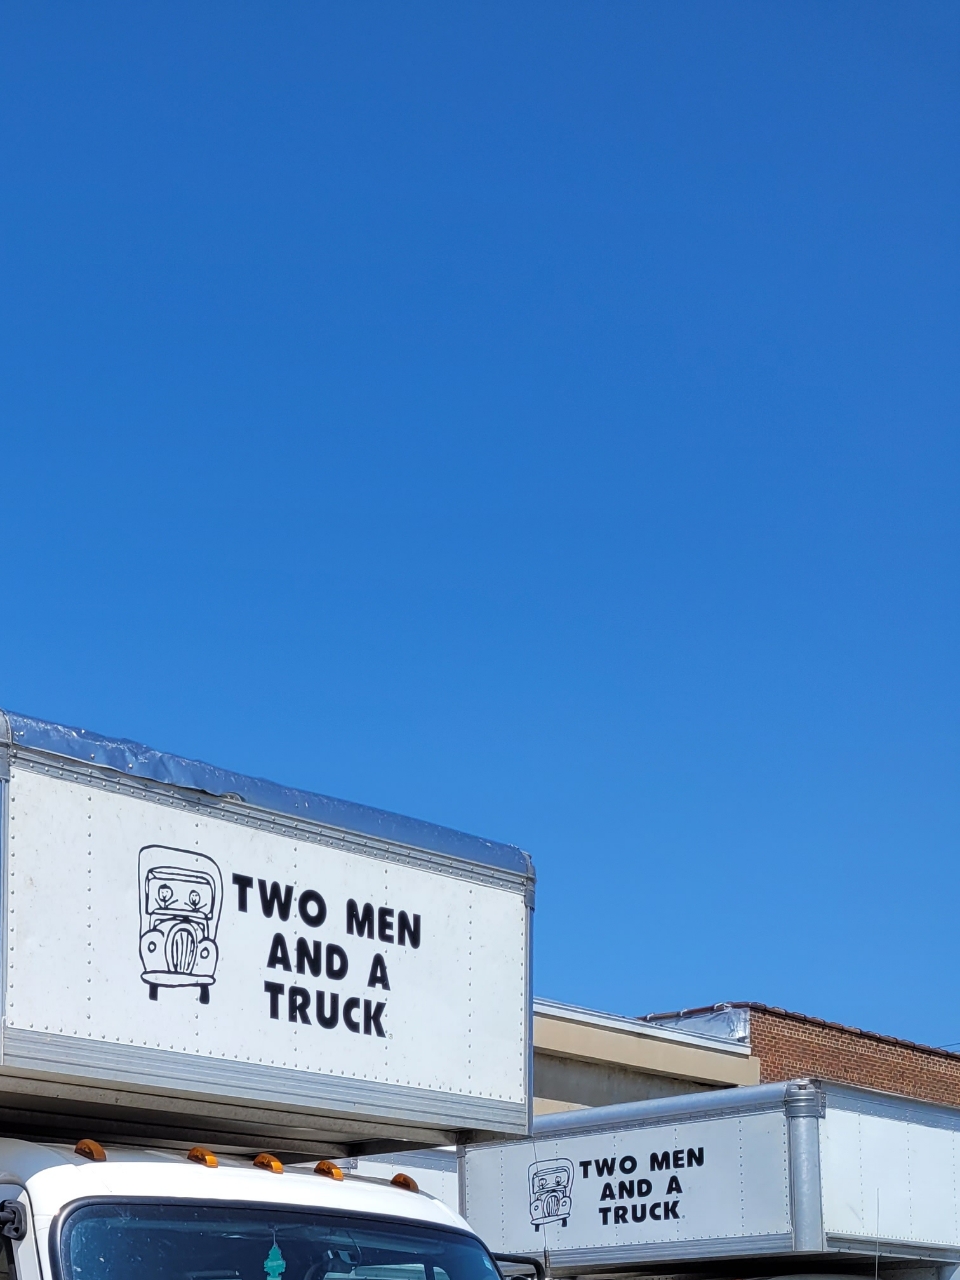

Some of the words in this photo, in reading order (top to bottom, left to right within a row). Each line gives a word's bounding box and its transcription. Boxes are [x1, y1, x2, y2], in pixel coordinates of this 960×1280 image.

[232, 872, 327, 928] TWO
[346, 898, 422, 949] MEN
[266, 932, 348, 981] AND
[367, 953, 391, 991] A
[264, 980, 387, 1038] TRUCK
[578, 1155, 637, 1179] TWO
[650, 1147, 704, 1172] MEN
[599, 1179, 653, 1201] AND
[666, 1175, 683, 1194] A
[598, 1200, 680, 1225] TRUCK
